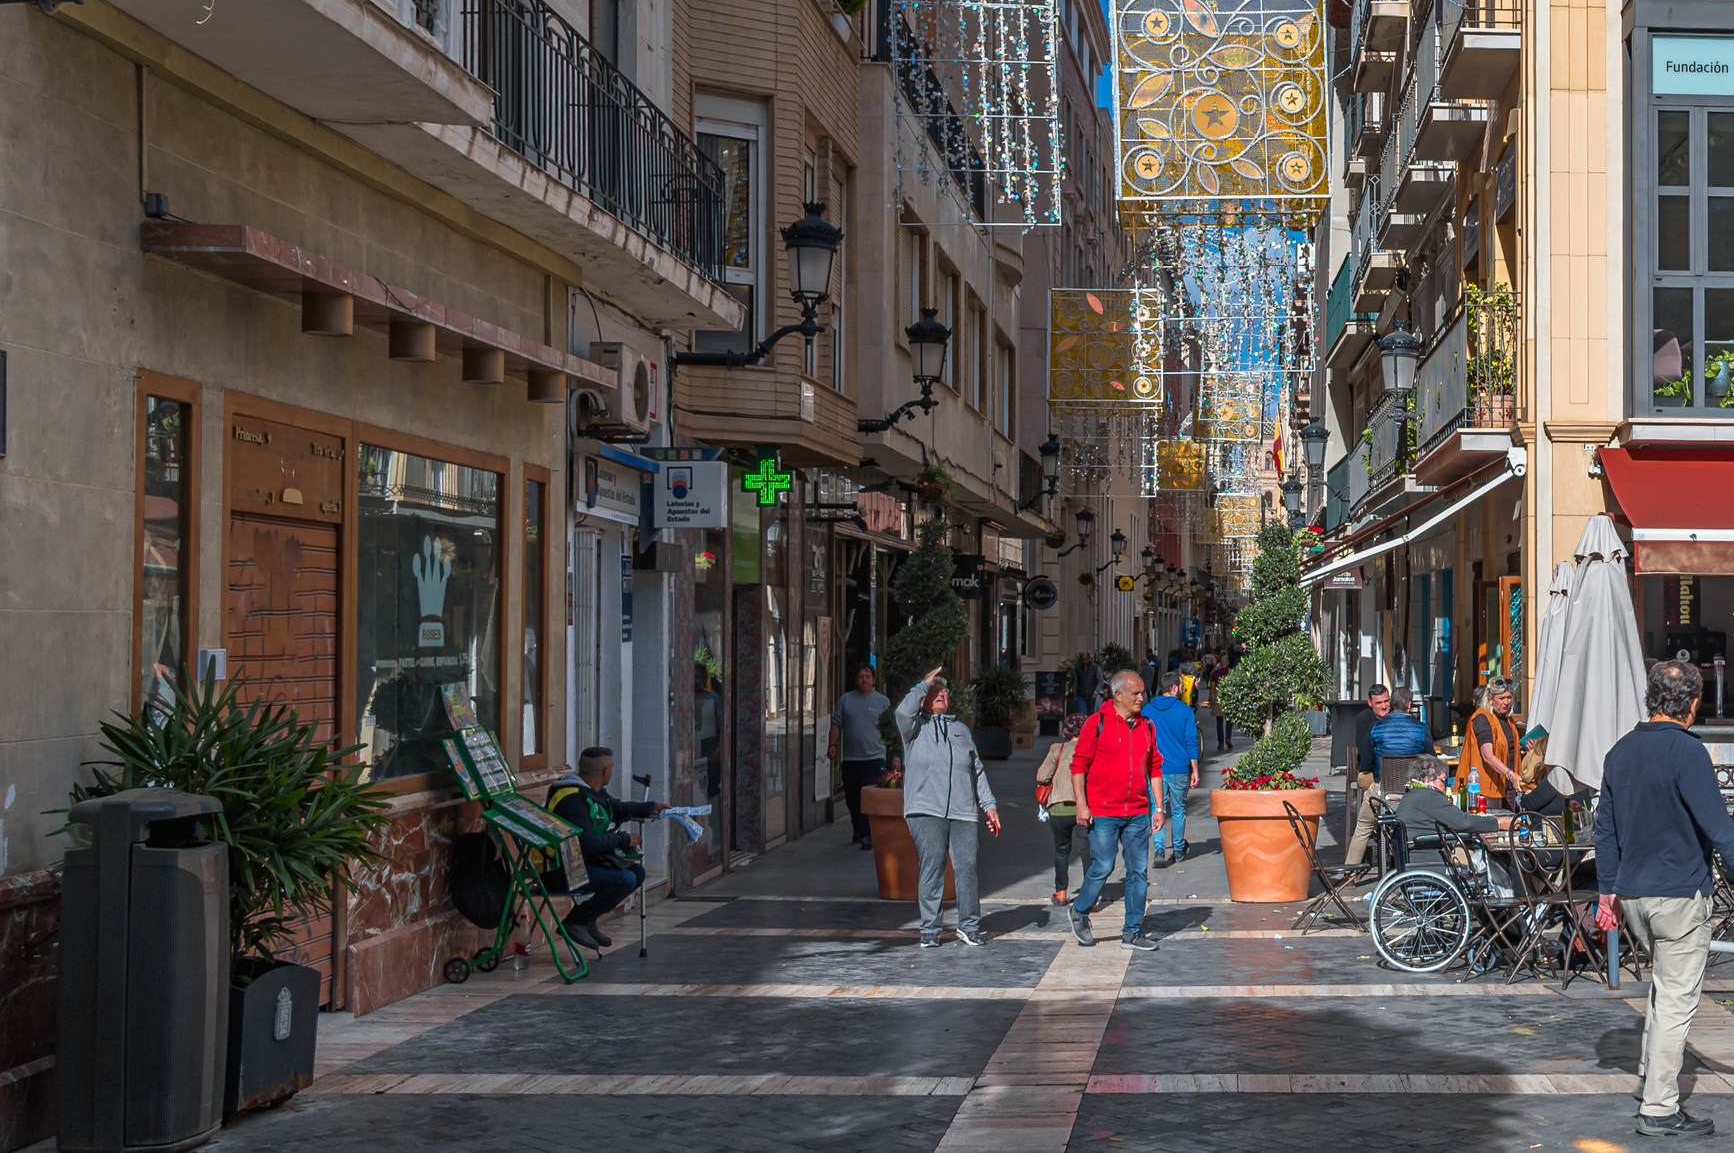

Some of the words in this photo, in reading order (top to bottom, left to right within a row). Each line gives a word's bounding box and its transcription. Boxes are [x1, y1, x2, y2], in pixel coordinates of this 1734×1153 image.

[1666, 60, 1729, 74] Fundación
[667, 500, 693, 508] Loterías
[667, 508, 699, 516] Apuestas
[951, 573, 979, 588] mak
[422, 629, 441, 641] ROSES
[398, 657, 416, 668] PASTEL
